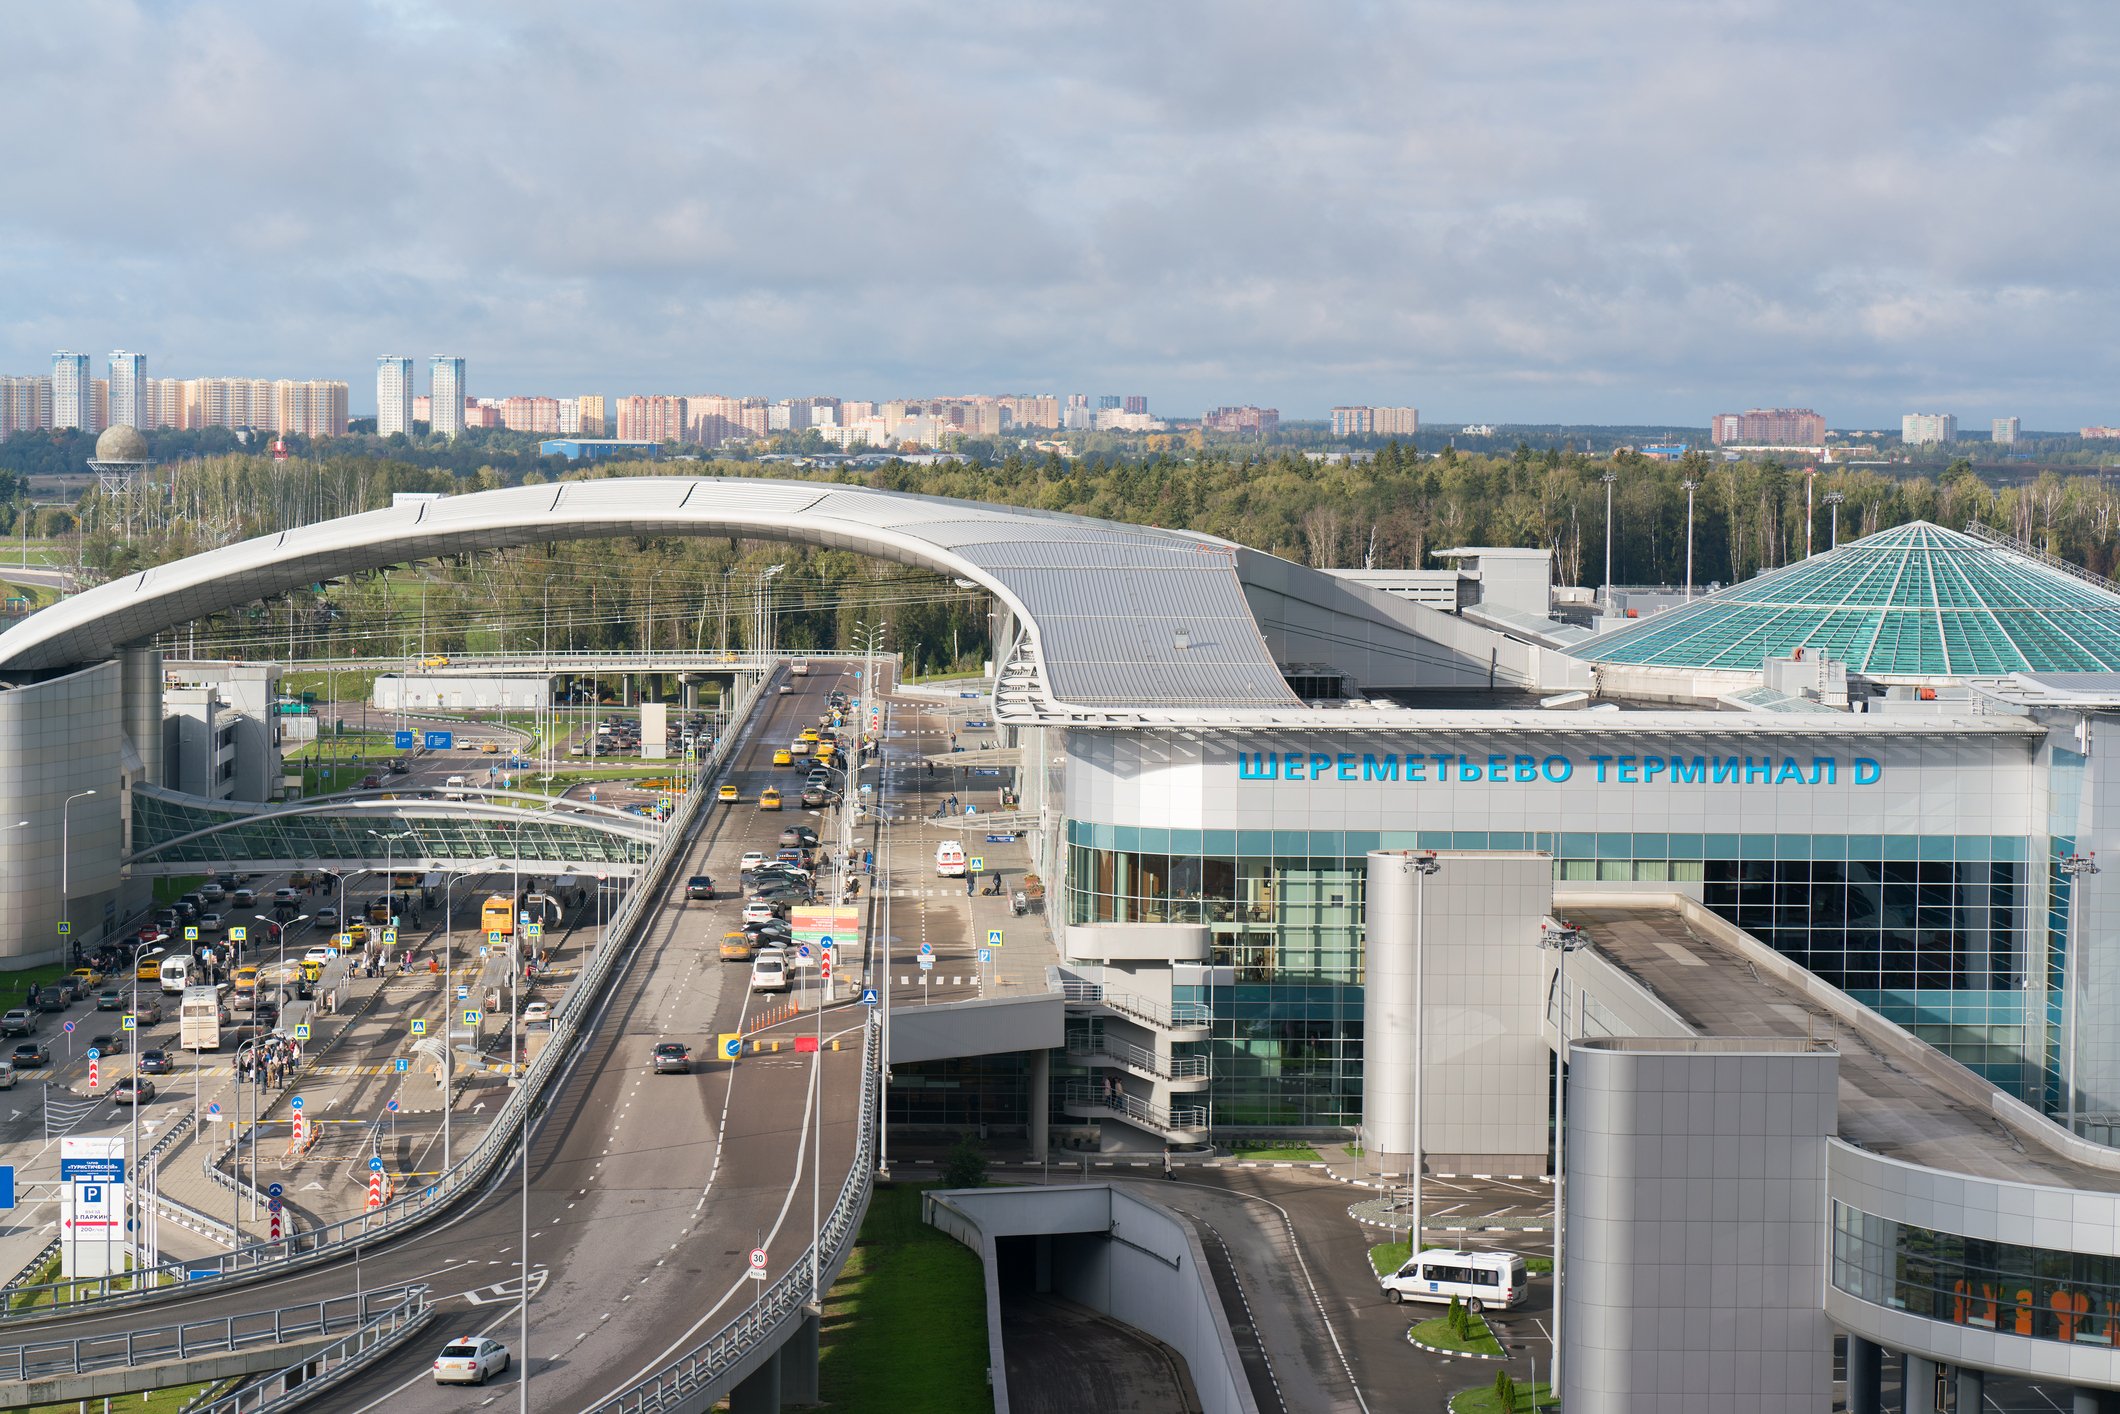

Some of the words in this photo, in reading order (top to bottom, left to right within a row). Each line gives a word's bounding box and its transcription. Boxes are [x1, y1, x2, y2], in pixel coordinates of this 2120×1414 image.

[1238, 751, 1574, 783] ШЕРЕМЕТЬЕВО
[1588, 755, 1837, 785] ТЕРМИНАЛ
[1853, 757, 1882, 786] D
